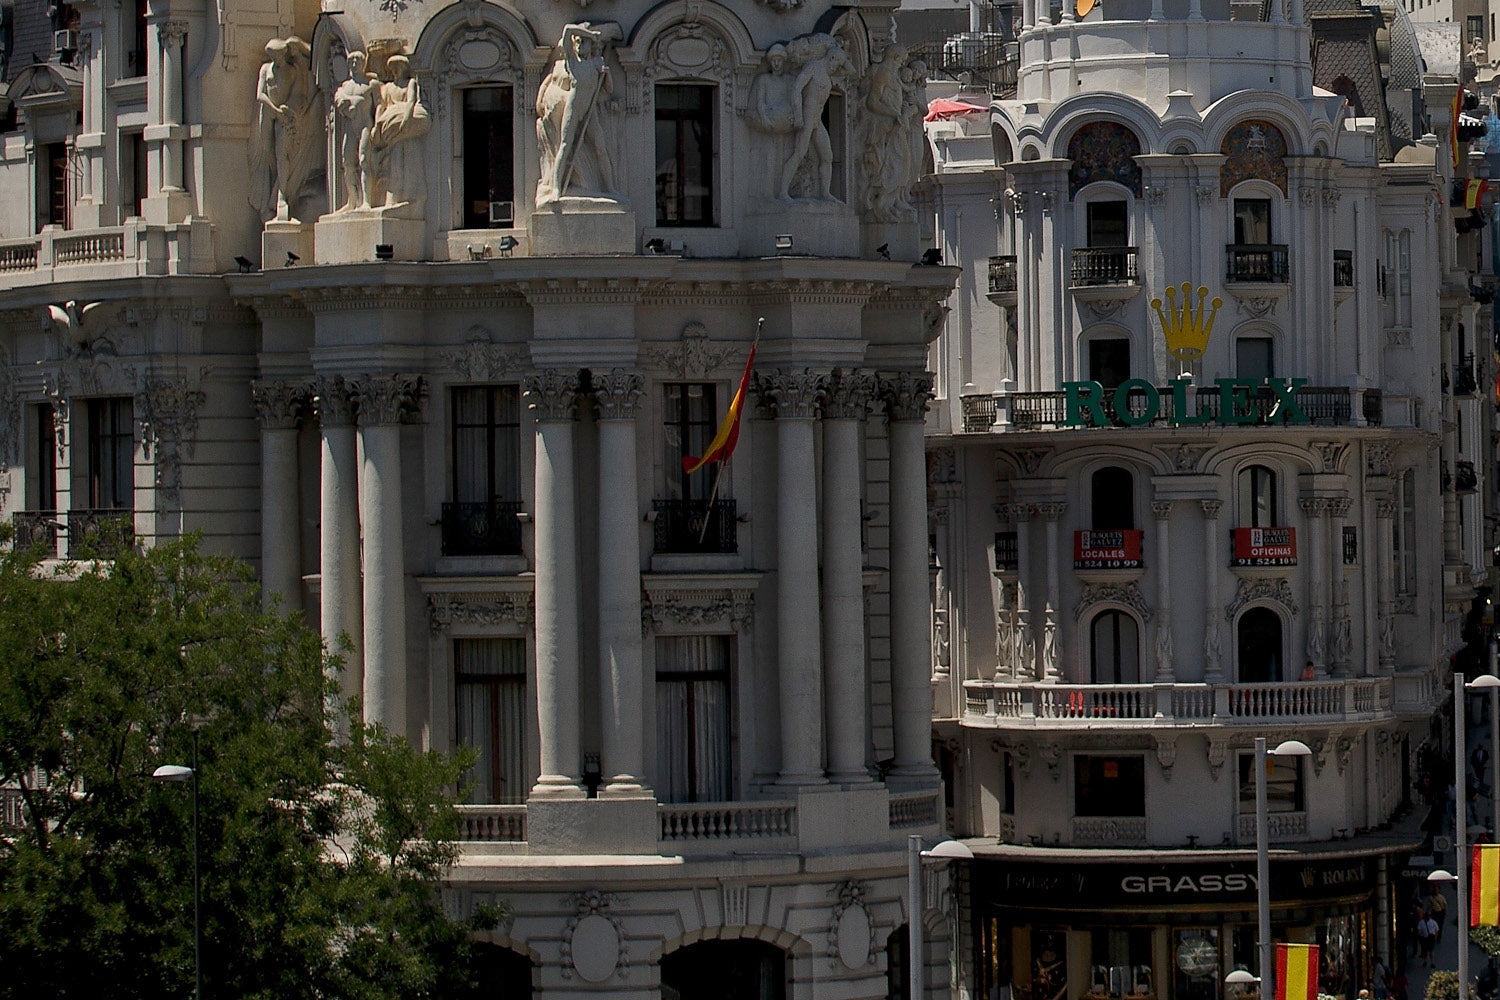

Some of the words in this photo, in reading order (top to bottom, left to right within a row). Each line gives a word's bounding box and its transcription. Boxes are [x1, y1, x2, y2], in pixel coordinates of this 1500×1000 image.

[1061, 378, 1309, 427] ROLEX
[1081, 550, 1125, 558] LOCALES
[1251, 547, 1291, 555] OFICINAS
[1123, 559, 1138, 567] 99
